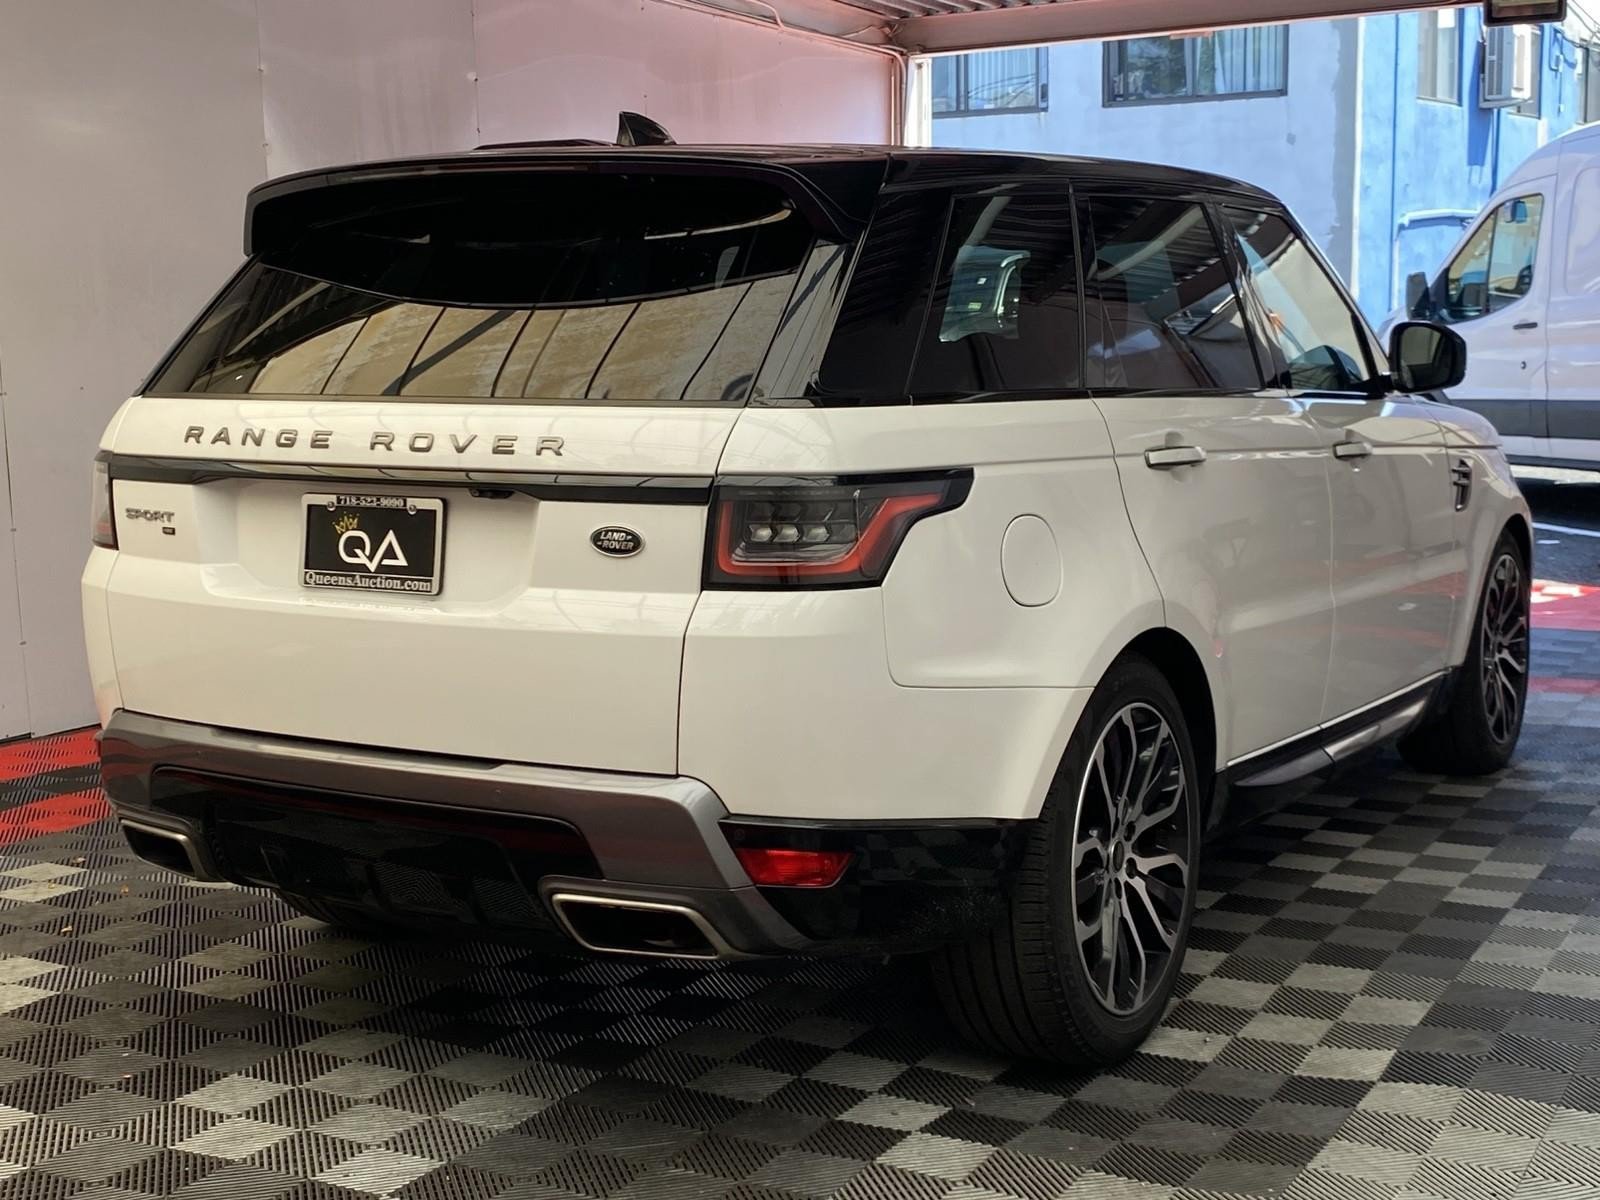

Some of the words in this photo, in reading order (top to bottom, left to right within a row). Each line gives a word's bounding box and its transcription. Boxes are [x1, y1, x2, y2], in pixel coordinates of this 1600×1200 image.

[183, 425, 333, 449] RANGE
[369, 431, 566, 457] ROVER
[125, 507, 175, 523] SPORT
[600, 531, 626, 541] LAND
[338, 529, 409, 573] QA
[602, 540, 634, 551] ROVER
[305, 571, 431, 592] QueensAuction.com
